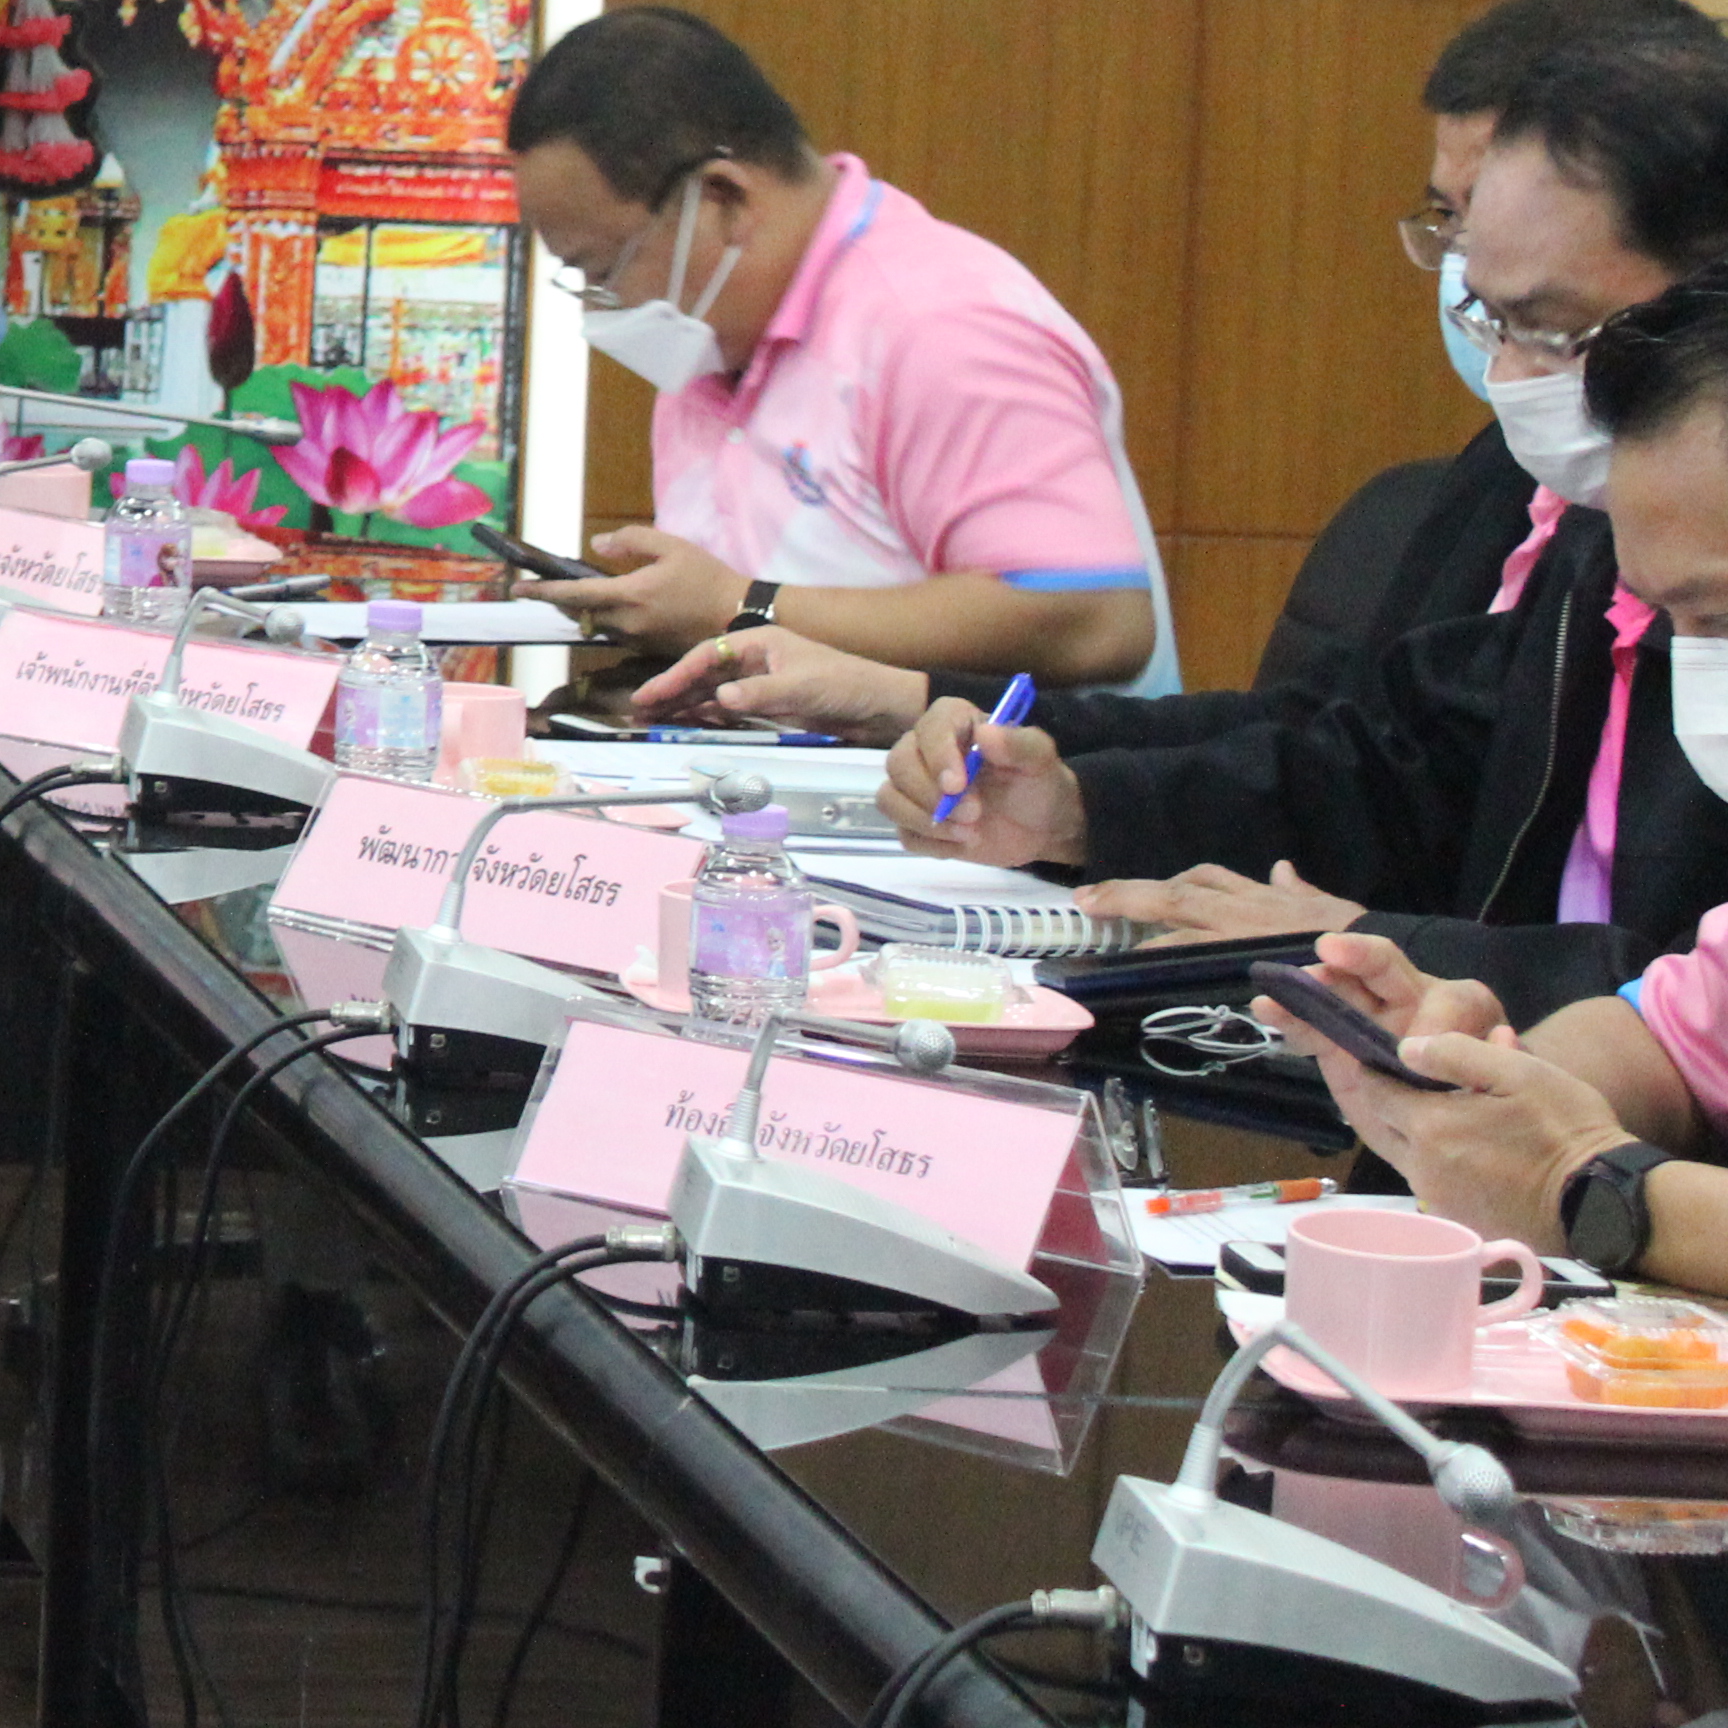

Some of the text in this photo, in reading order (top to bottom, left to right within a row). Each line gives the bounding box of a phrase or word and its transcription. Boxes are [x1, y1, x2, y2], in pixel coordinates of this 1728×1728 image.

[356, 824, 623, 907] พัฒนากจังหวัดยโสธร
